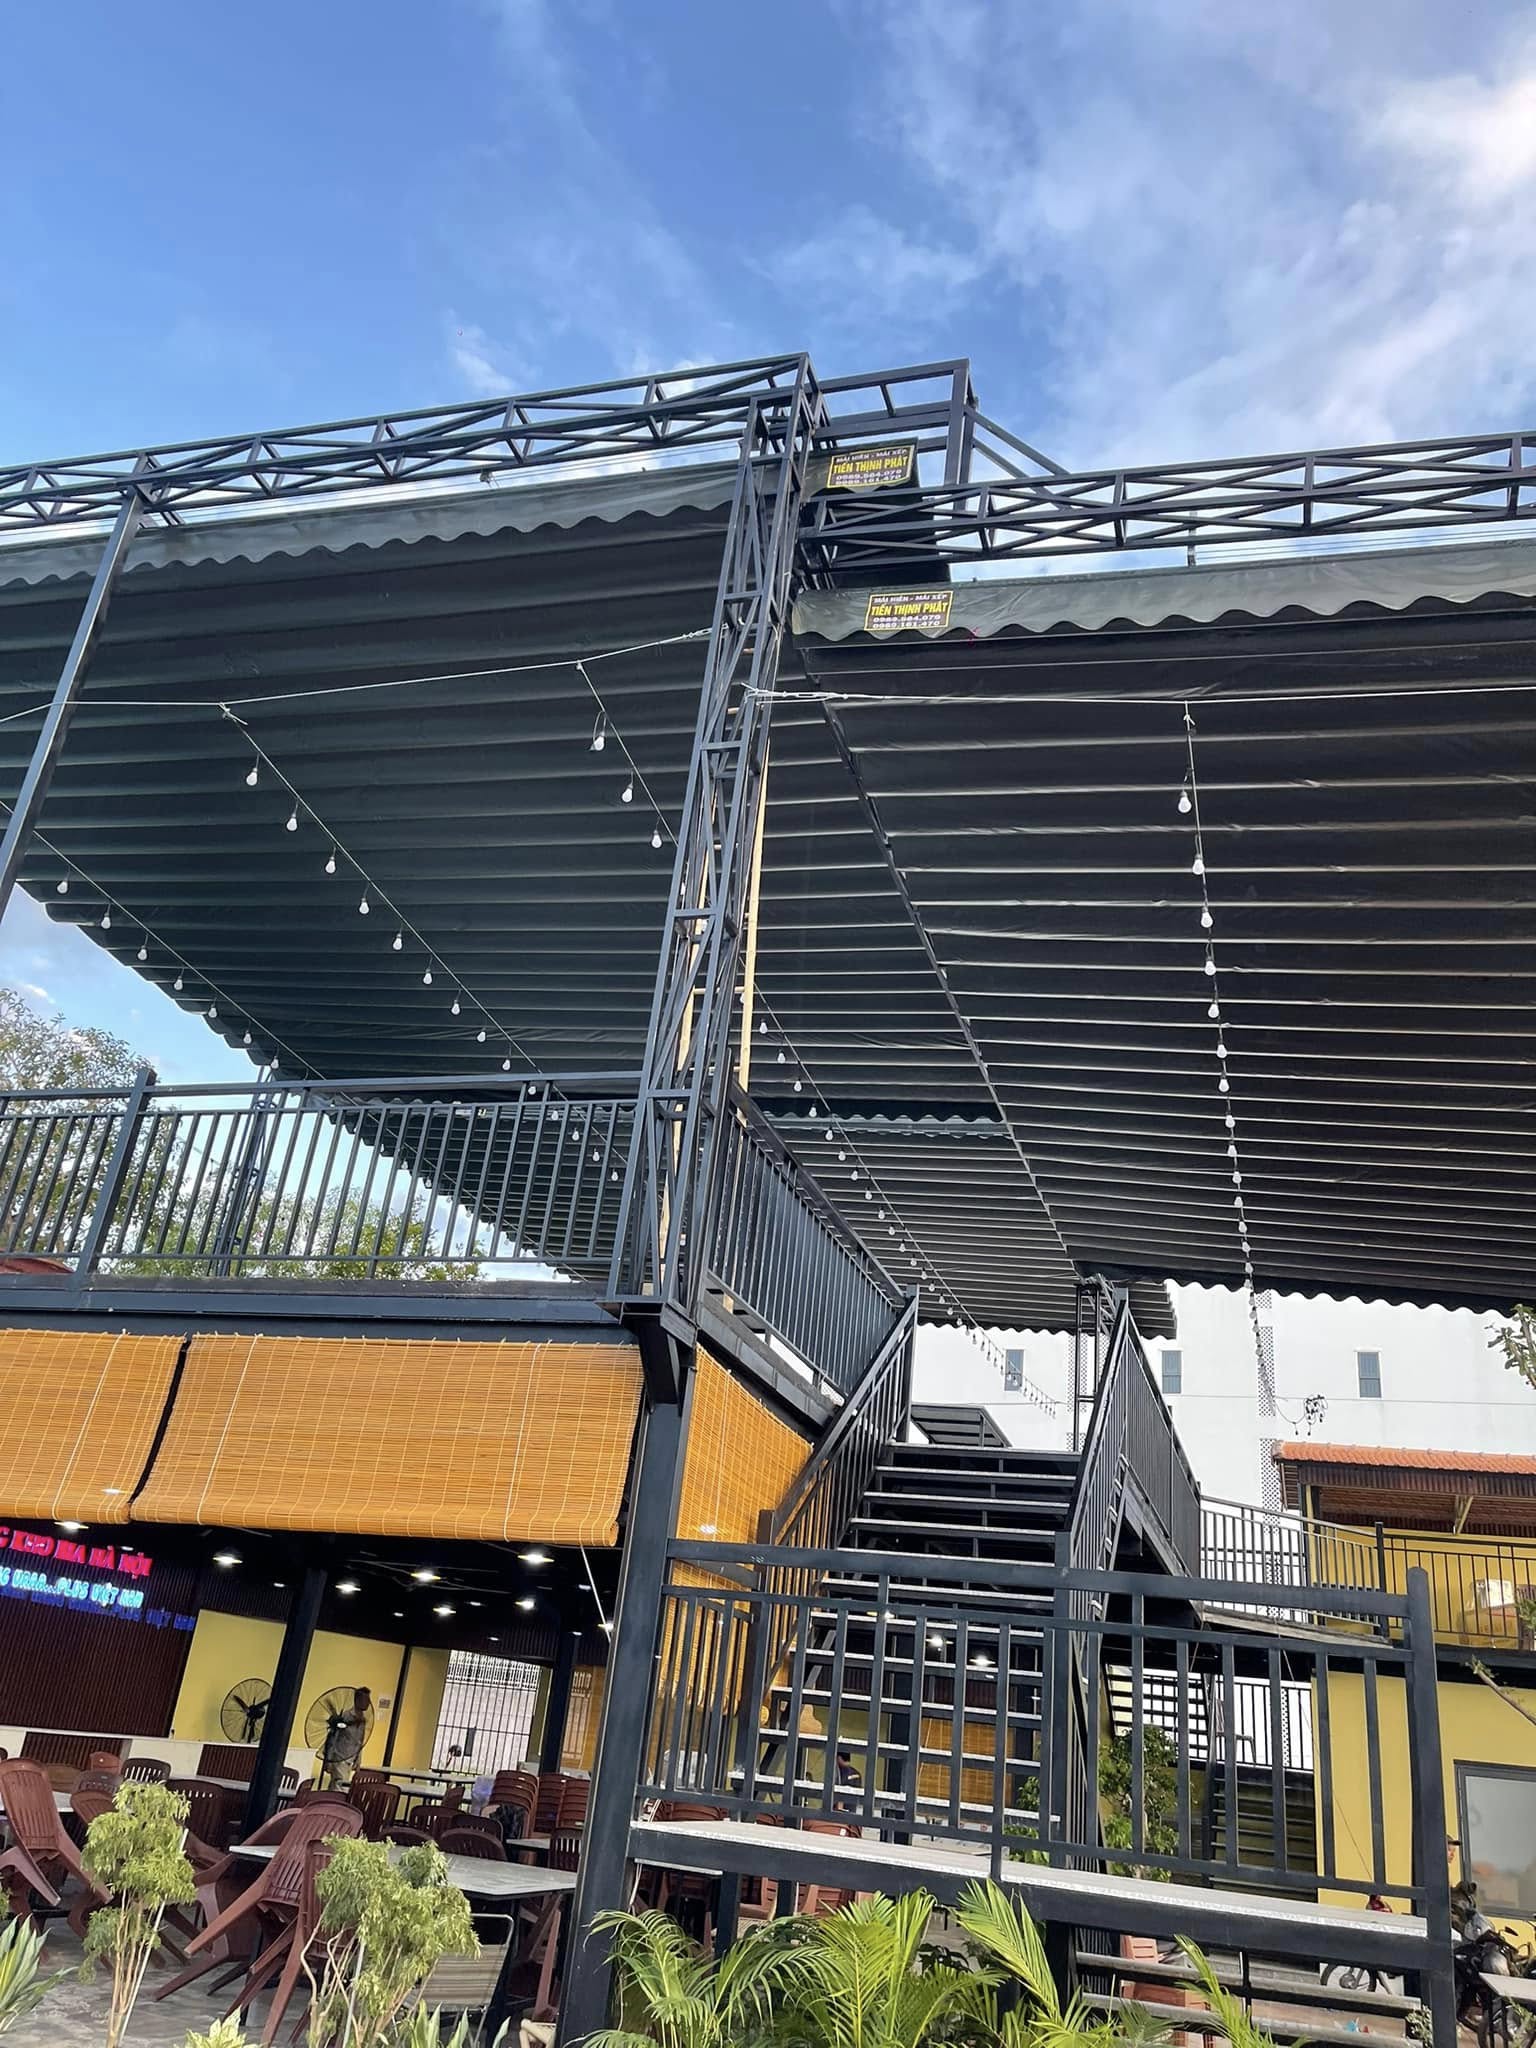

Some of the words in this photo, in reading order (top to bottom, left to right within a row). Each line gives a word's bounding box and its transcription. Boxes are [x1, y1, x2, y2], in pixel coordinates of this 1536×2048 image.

[833, 461, 853, 474] TIẾN
[855, 459, 882, 474] THỊNH
[884, 455, 908, 470] PHÁT
[871, 602, 892, 616] TIẾN
[894, 604, 921, 616] THỊNH
[923, 600, 948, 614] PHÁT
[10, 1530, 54, 1556] KHO
[89, 1545, 116, 1570] HÀ
[118, 1553, 153, 1580] NỘI
[90, 1582, 119, 1608] VIỆT
